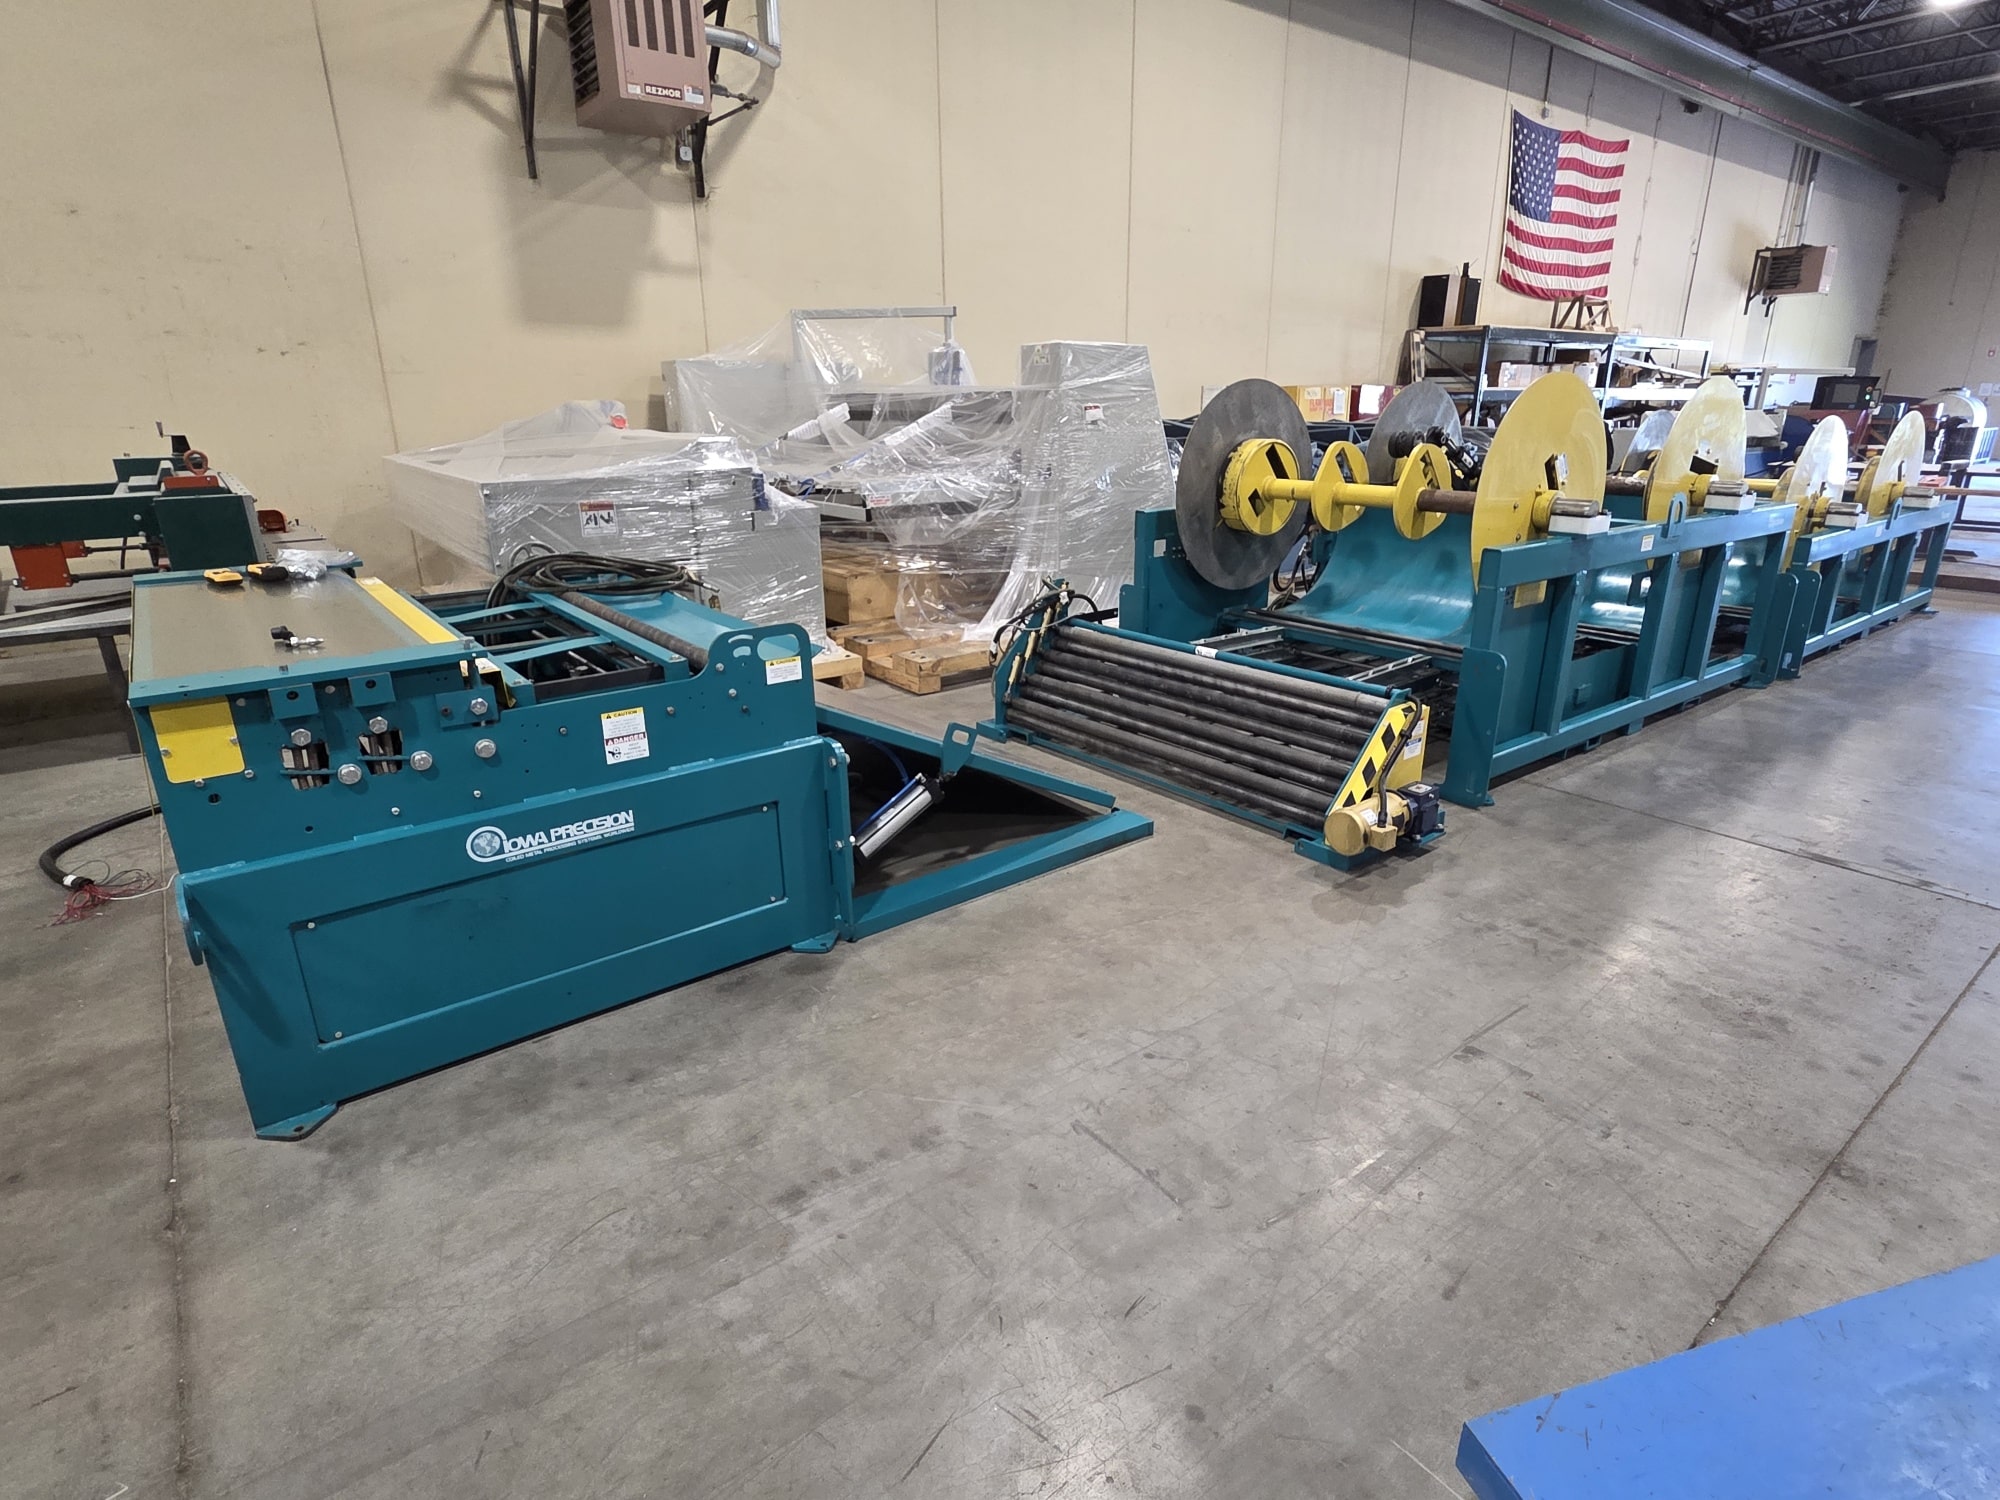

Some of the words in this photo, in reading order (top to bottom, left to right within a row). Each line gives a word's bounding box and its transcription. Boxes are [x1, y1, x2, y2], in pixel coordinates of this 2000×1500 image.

[645, 85, 682, 98] REZNOR
[613, 709, 638, 718] CAUTION
[613, 733, 644, 744] DANGER
[503, 831, 549, 854] IOWA
[550, 810, 634, 841] PRECISION
[505, 854, 525, 863] COILED
[525, 849, 543, 858] METAL
